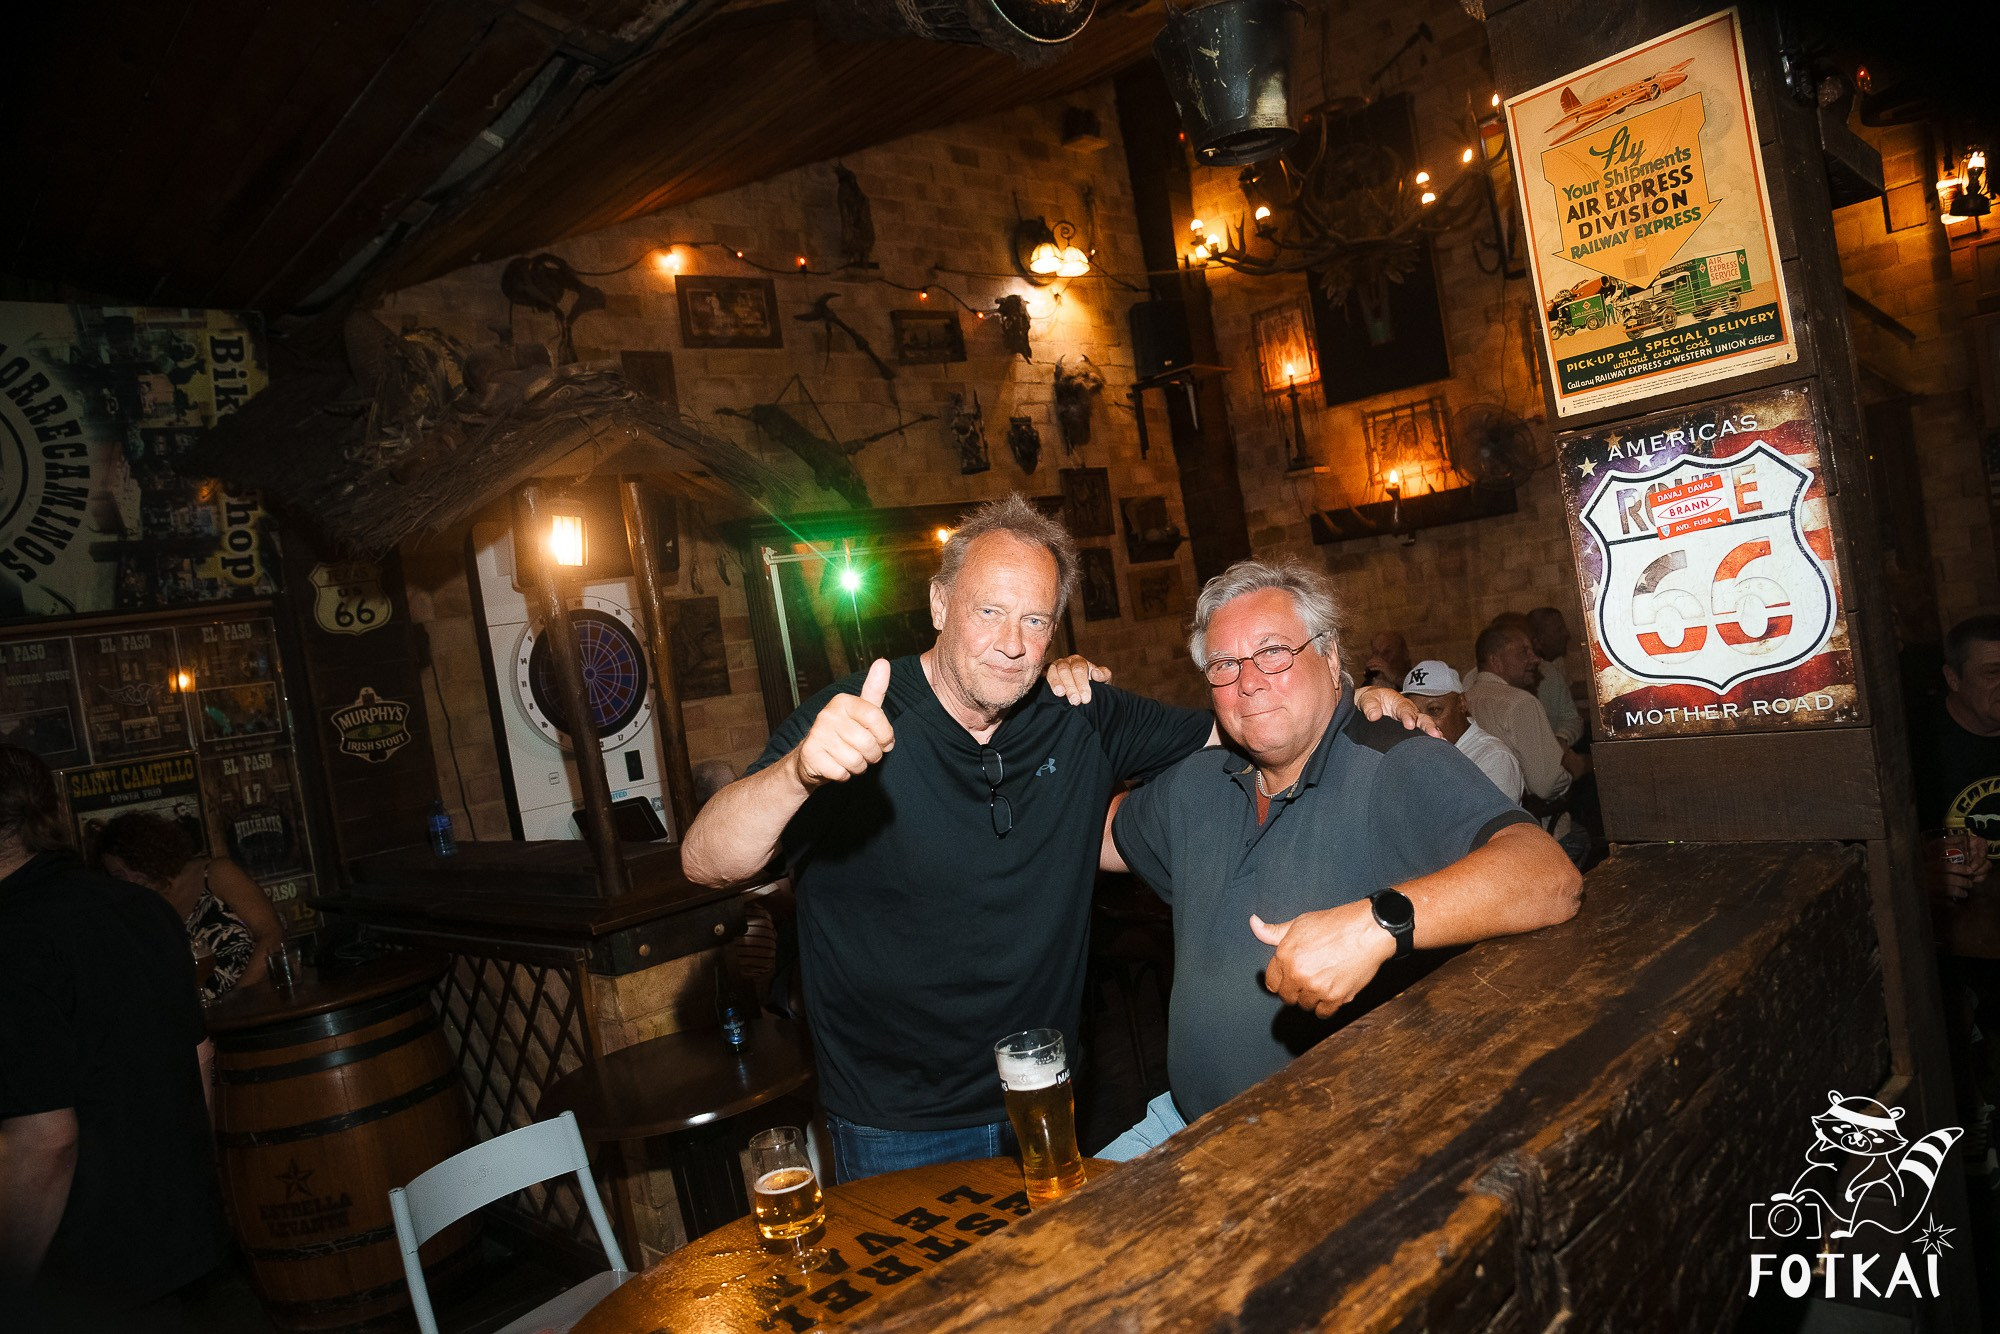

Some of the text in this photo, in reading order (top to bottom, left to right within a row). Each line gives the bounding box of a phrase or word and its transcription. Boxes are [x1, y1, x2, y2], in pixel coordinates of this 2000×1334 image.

[1589, 126, 1646, 170] Fly
[1562, 146, 1692, 201] Your Shipments
[1567, 165, 1693, 224] AIR EXPRESS
[1578, 190, 1688, 239] DIVISION
[1571, 207, 1702, 260] RAILWAY EXPRESS
[1708, 256, 1723, 265] AIR
[1709, 260, 1738, 272] EXPRESS
[1711, 267, 1739, 281] SERVICE
[1566, 311, 1776, 372] PICK-UP and SPECIAL DELIVERY
[1613, 338, 1711, 370] without extra cost
[1567, 380, 1581, 390] Call
[1581, 378, 1595, 388] any
[1595, 368, 1627, 383] RAILWAY
[1628, 360, 1662, 376] EXPRESS
[1672, 349, 1713, 364] WESTERN
[1715, 338, 1747, 353] UNION
[1749, 332, 1776, 345] office
[1608, 414, 1759, 461] AMERICA'S
[0, 343, 90, 583] ORRECAMINOS
[210, 336, 258, 580] Bik hop
[1657, 481, 1714, 503] DAVAJ DAVAJ
[1670, 498, 1710, 517] BRANN
[1676, 517, 1713, 533] AVD. FUSA
[335, 598, 376, 628] 66
[1632, 536, 1793, 664] 66
[100, 633, 151, 654] EL PASO
[202, 623, 252, 643] EL PASO
[13, 644, 46, 662] PASO
[1408, 668, 1429, 686] NY
[1625, 695, 1834, 727] MOTHER ROAD
[347, 732, 405, 752] IRISH STOUT
[72, 758, 194, 799] SANTI CAMPILLO
[223, 752, 273, 775] EL PASO
[243, 783, 261, 805] 17
[263, 882, 298, 902] PASO
